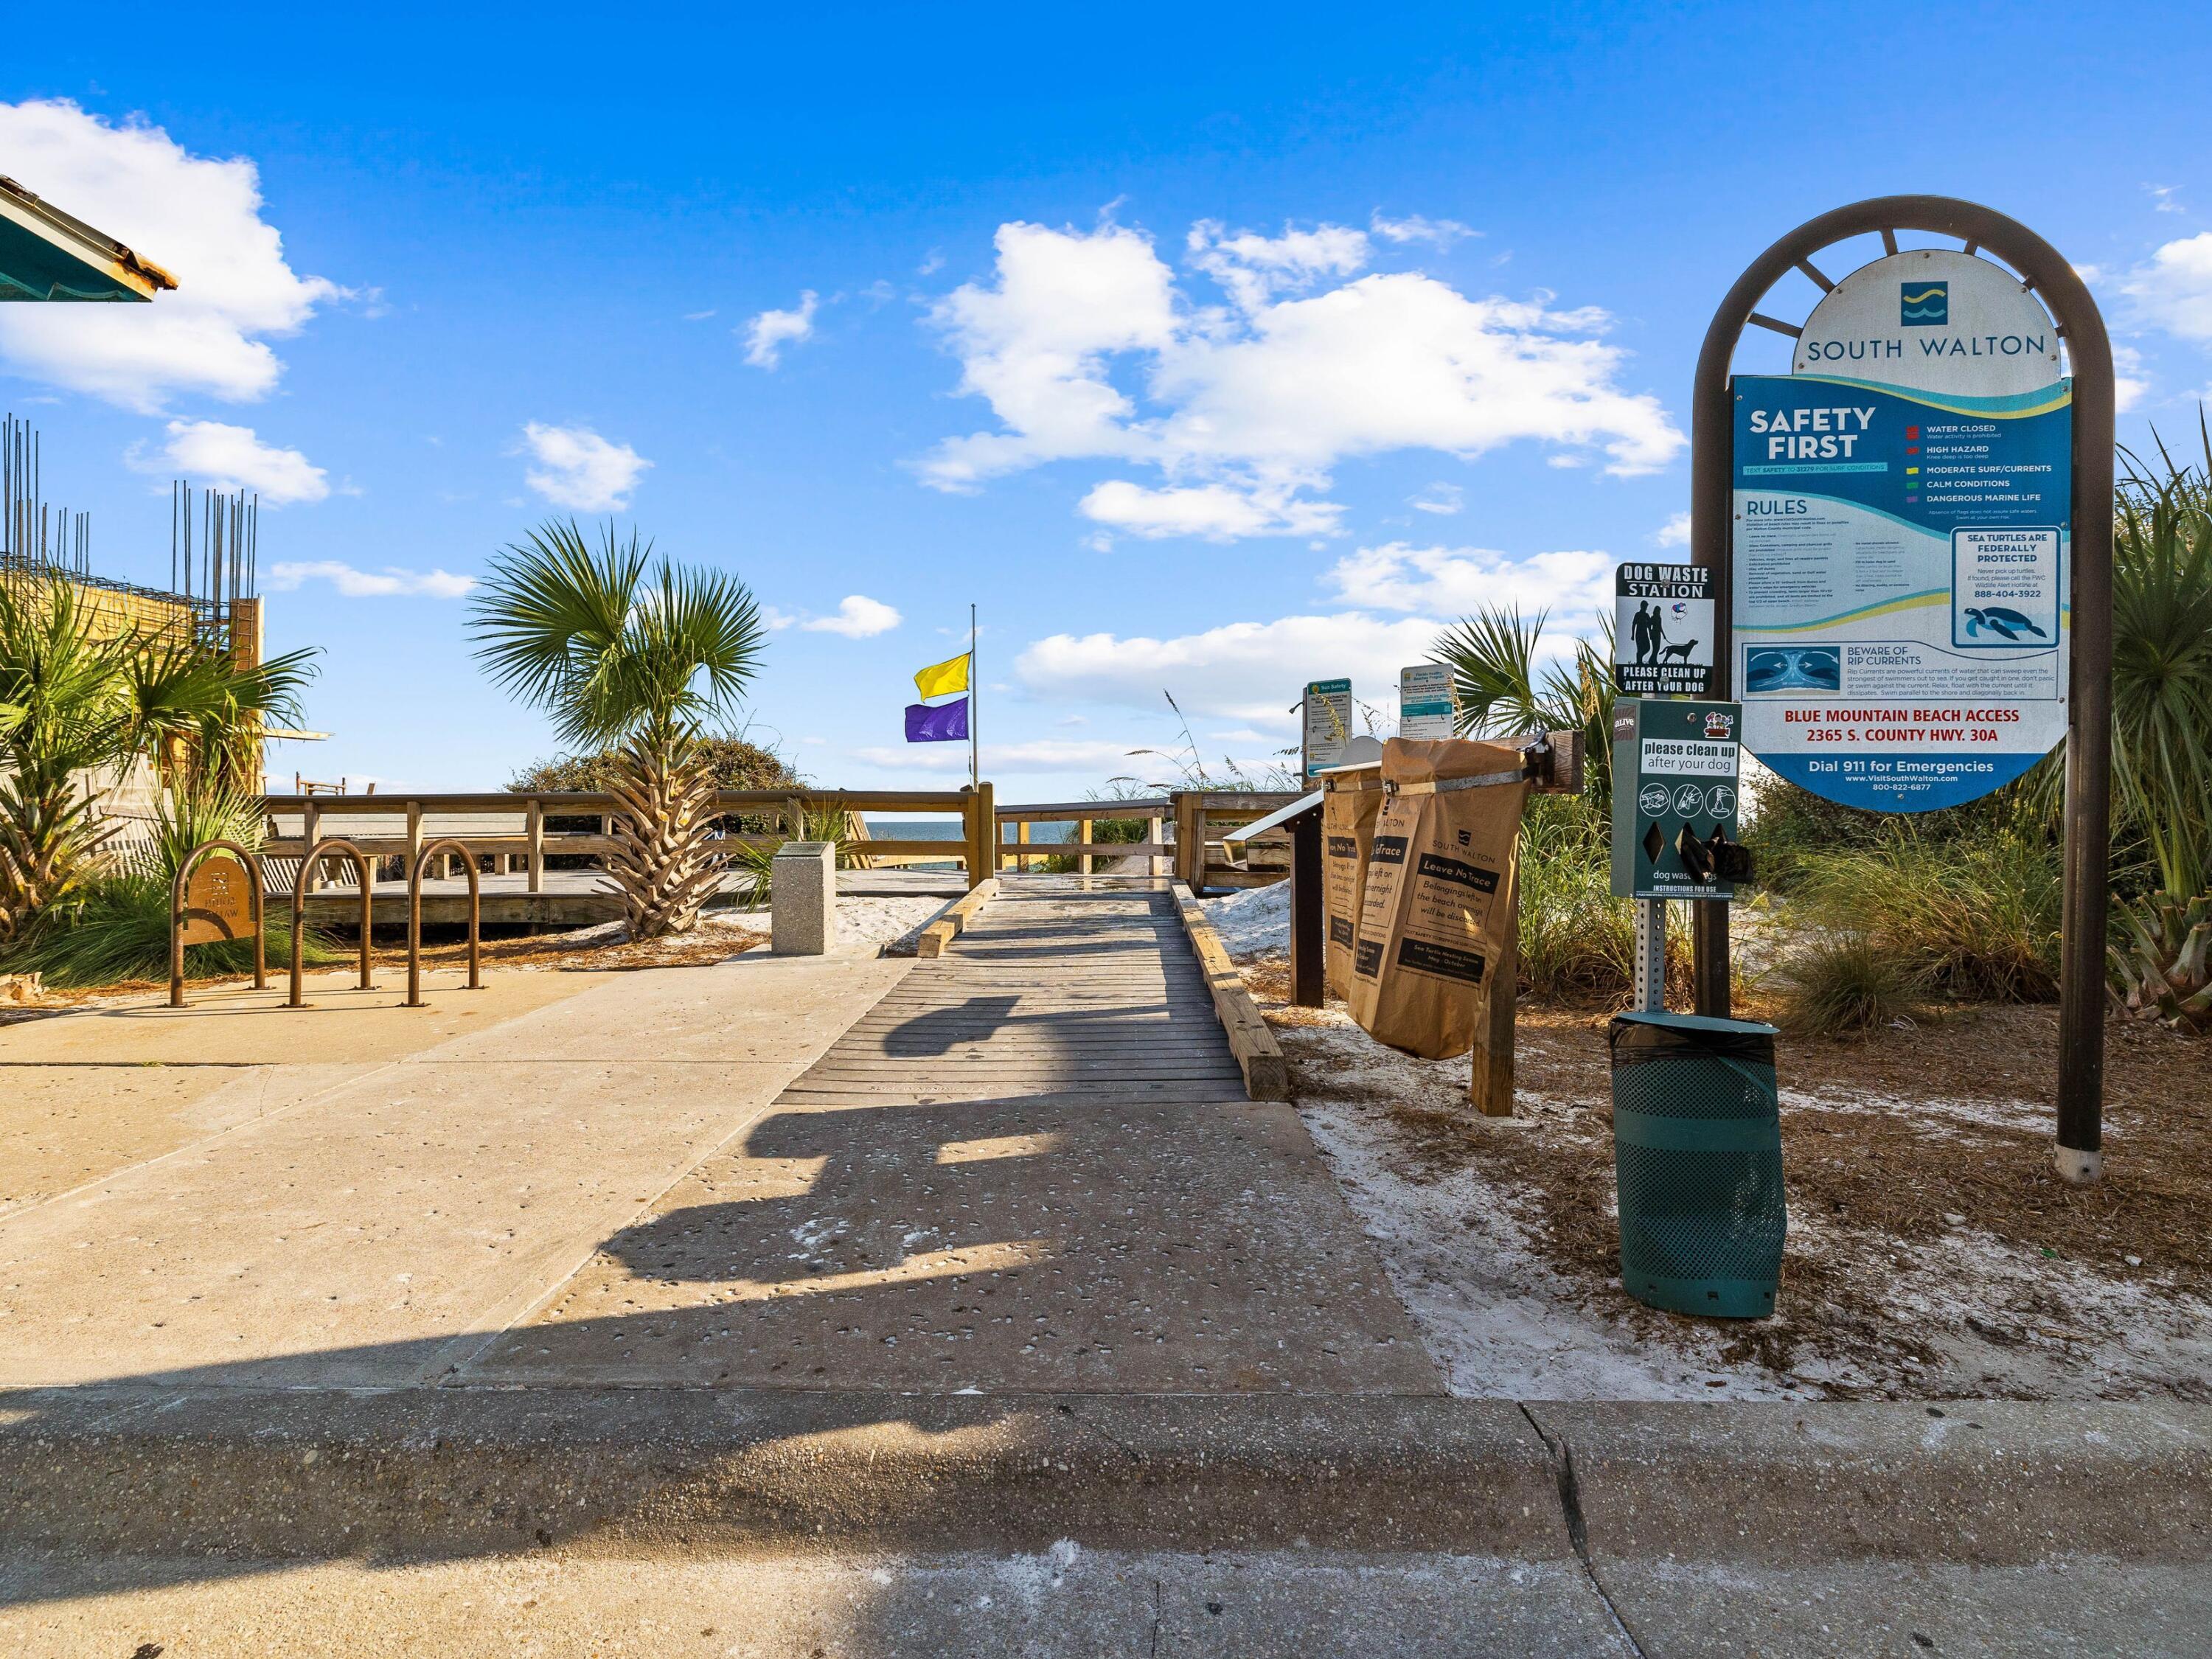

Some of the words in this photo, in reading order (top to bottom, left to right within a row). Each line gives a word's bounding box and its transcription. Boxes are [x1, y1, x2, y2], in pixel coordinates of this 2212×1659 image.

[1808, 338, 1902, 362] SOUTH
[1919, 335, 2045, 357] WALTON
[1749, 407, 1877, 434] SAFETY
[1768, 434, 1858, 459] FIRST
[1978, 465, 2052, 473] SURF/CURRENTS
[1747, 500, 1807, 515] RULES
[1978, 544, 2037, 552] FEDERALLY
[1978, 554, 2037, 563] PROTECTED
[1624, 565, 1652, 580] DOG
[1659, 566, 1708, 582] WASTE
[1629, 583, 1703, 598] STATION
[1848, 647, 1891, 655] BEWARE
[1893, 647, 1908, 655] OF
[1848, 656, 1863, 665] RIP
[1866, 656, 1921, 665] CURRENTS
[1623, 667, 1658, 677] PLEASE
[1661, 667, 1690, 678] CLEAN
[1694, 668, 1705, 678] UP
[1625, 681, 1654, 691] AFTER
[1658, 681, 1683, 692] YOUR
[1686, 682, 1704, 692] DOG
[1785, 710, 1821, 723] BLUE
[1826, 709, 1907, 722] MOUNTAIN
[1913, 709, 1961, 722] BEACH
[1965, 709, 2020, 722] ACCESS
[1806, 729, 1842, 742] 2365
[1847, 729, 1860, 741] S.
[1865, 729, 1925, 742] COUNTY
[1930, 729, 1965, 741] HWY.
[1970, 729, 1998, 741] 30A
[1644, 742, 1683, 755] please
[1686, 743, 1718, 757] clean
[1721, 747, 1735, 758] up
[1648, 756, 1675, 768] after
[1678, 759, 1705, 771] your
[1708, 758, 1731, 773] dog
[1809, 761, 1838, 772] Dial
[1843, 761, 1865, 773] 911
[1870, 760, 1892, 772] for
[1896, 760, 1994, 774] Emergencies
[1433, 840, 1460, 852] SOUTH
[1461, 848, 1496, 864] WALTON
[1424, 860, 1453, 875] Leave
[1455, 868, 1467, 879] No
[1468, 872, 1491, 887] Trace
[1653, 870, 1670, 881] dog
[1423, 880, 1465, 897] Belongings
[1417, 892, 1430, 901] the
[1432, 896, 1455, 907] beach
[1421, 907, 1435, 915] will
[1437, 909, 1445, 918] be
